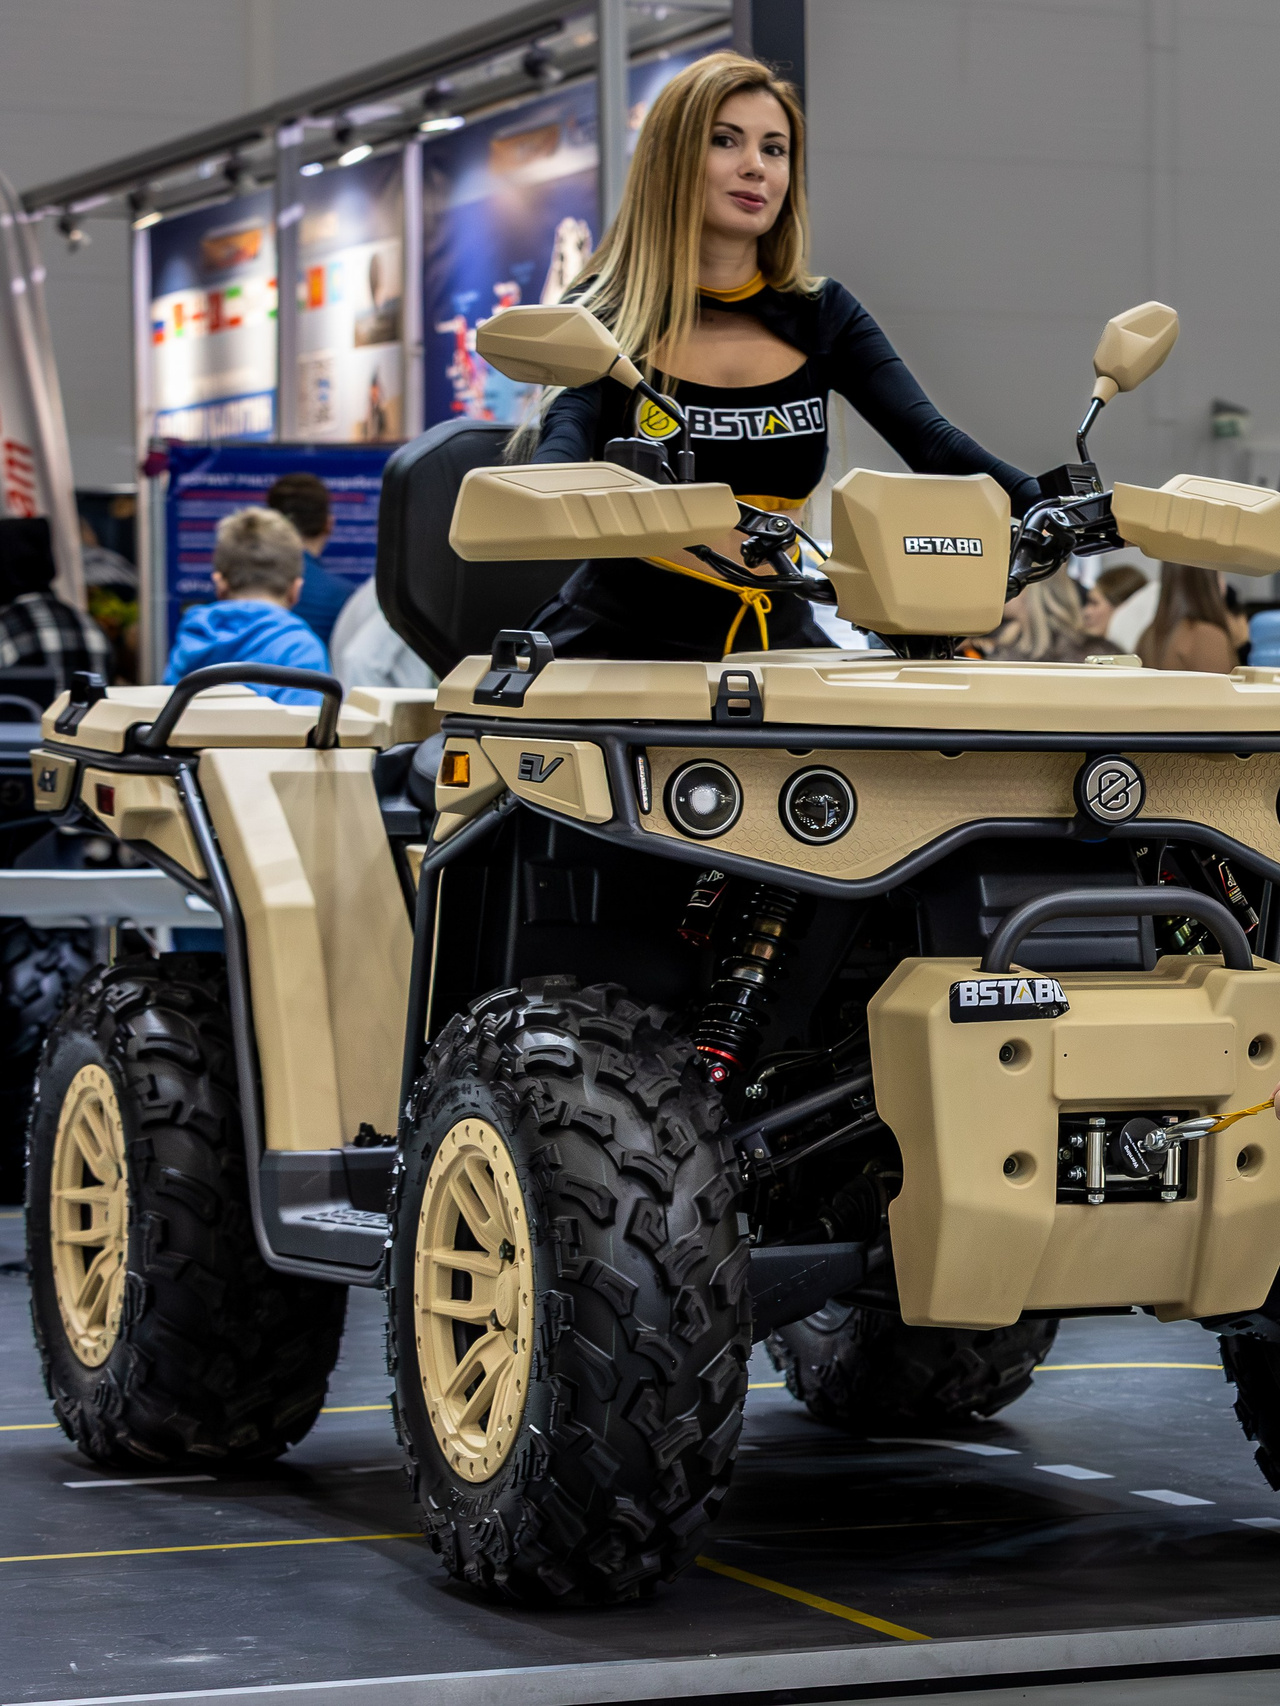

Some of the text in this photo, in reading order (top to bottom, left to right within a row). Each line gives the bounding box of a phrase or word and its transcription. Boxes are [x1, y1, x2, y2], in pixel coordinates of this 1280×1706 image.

[685, 397, 826, 440] BSTABO
[904, 537, 982, 555] BSTABO
[518, 752, 564, 783] EV
